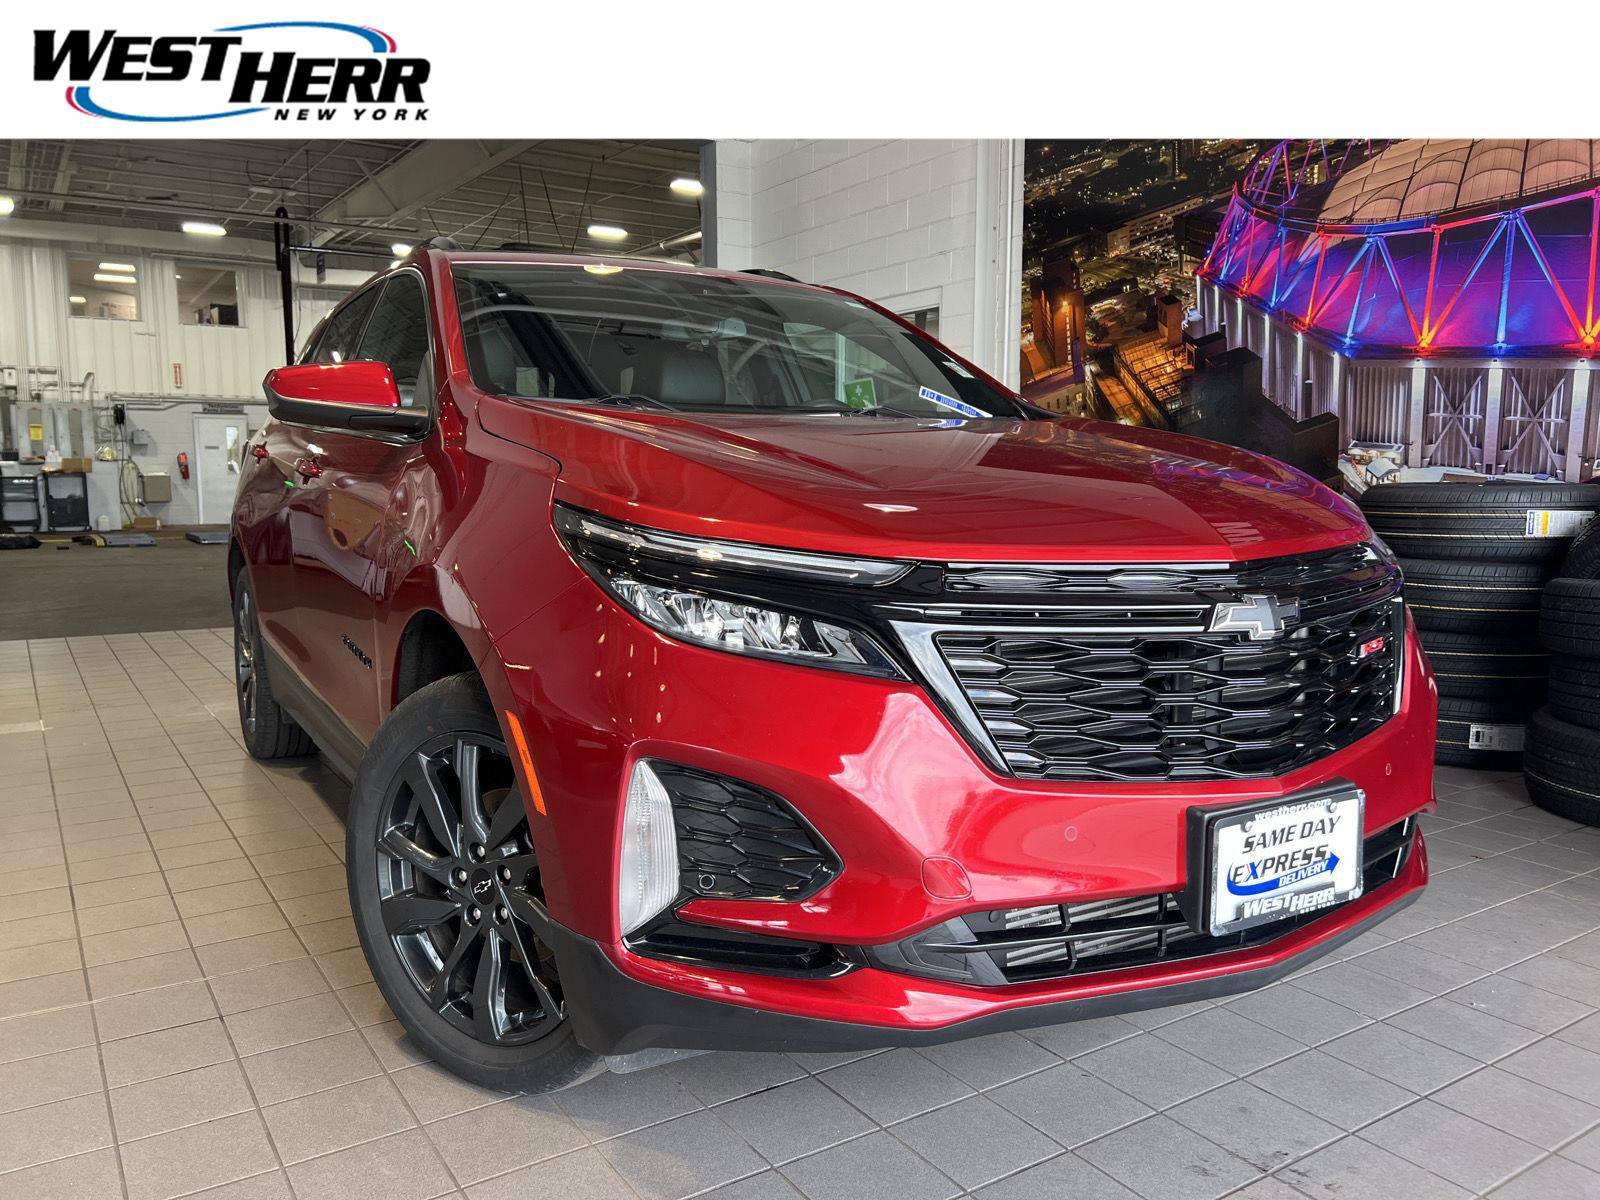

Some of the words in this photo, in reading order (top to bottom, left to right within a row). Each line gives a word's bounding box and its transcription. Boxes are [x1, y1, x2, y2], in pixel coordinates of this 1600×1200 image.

[1242, 825, 1297, 854] SAME
[1300, 816, 1341, 840] DAY
[1233, 844, 1329, 884] EXPRESS
[1278, 859, 1329, 888] DELIVERY
[1243, 892, 1294, 918] WEST
[1289, 887, 1335, 912] HERR
